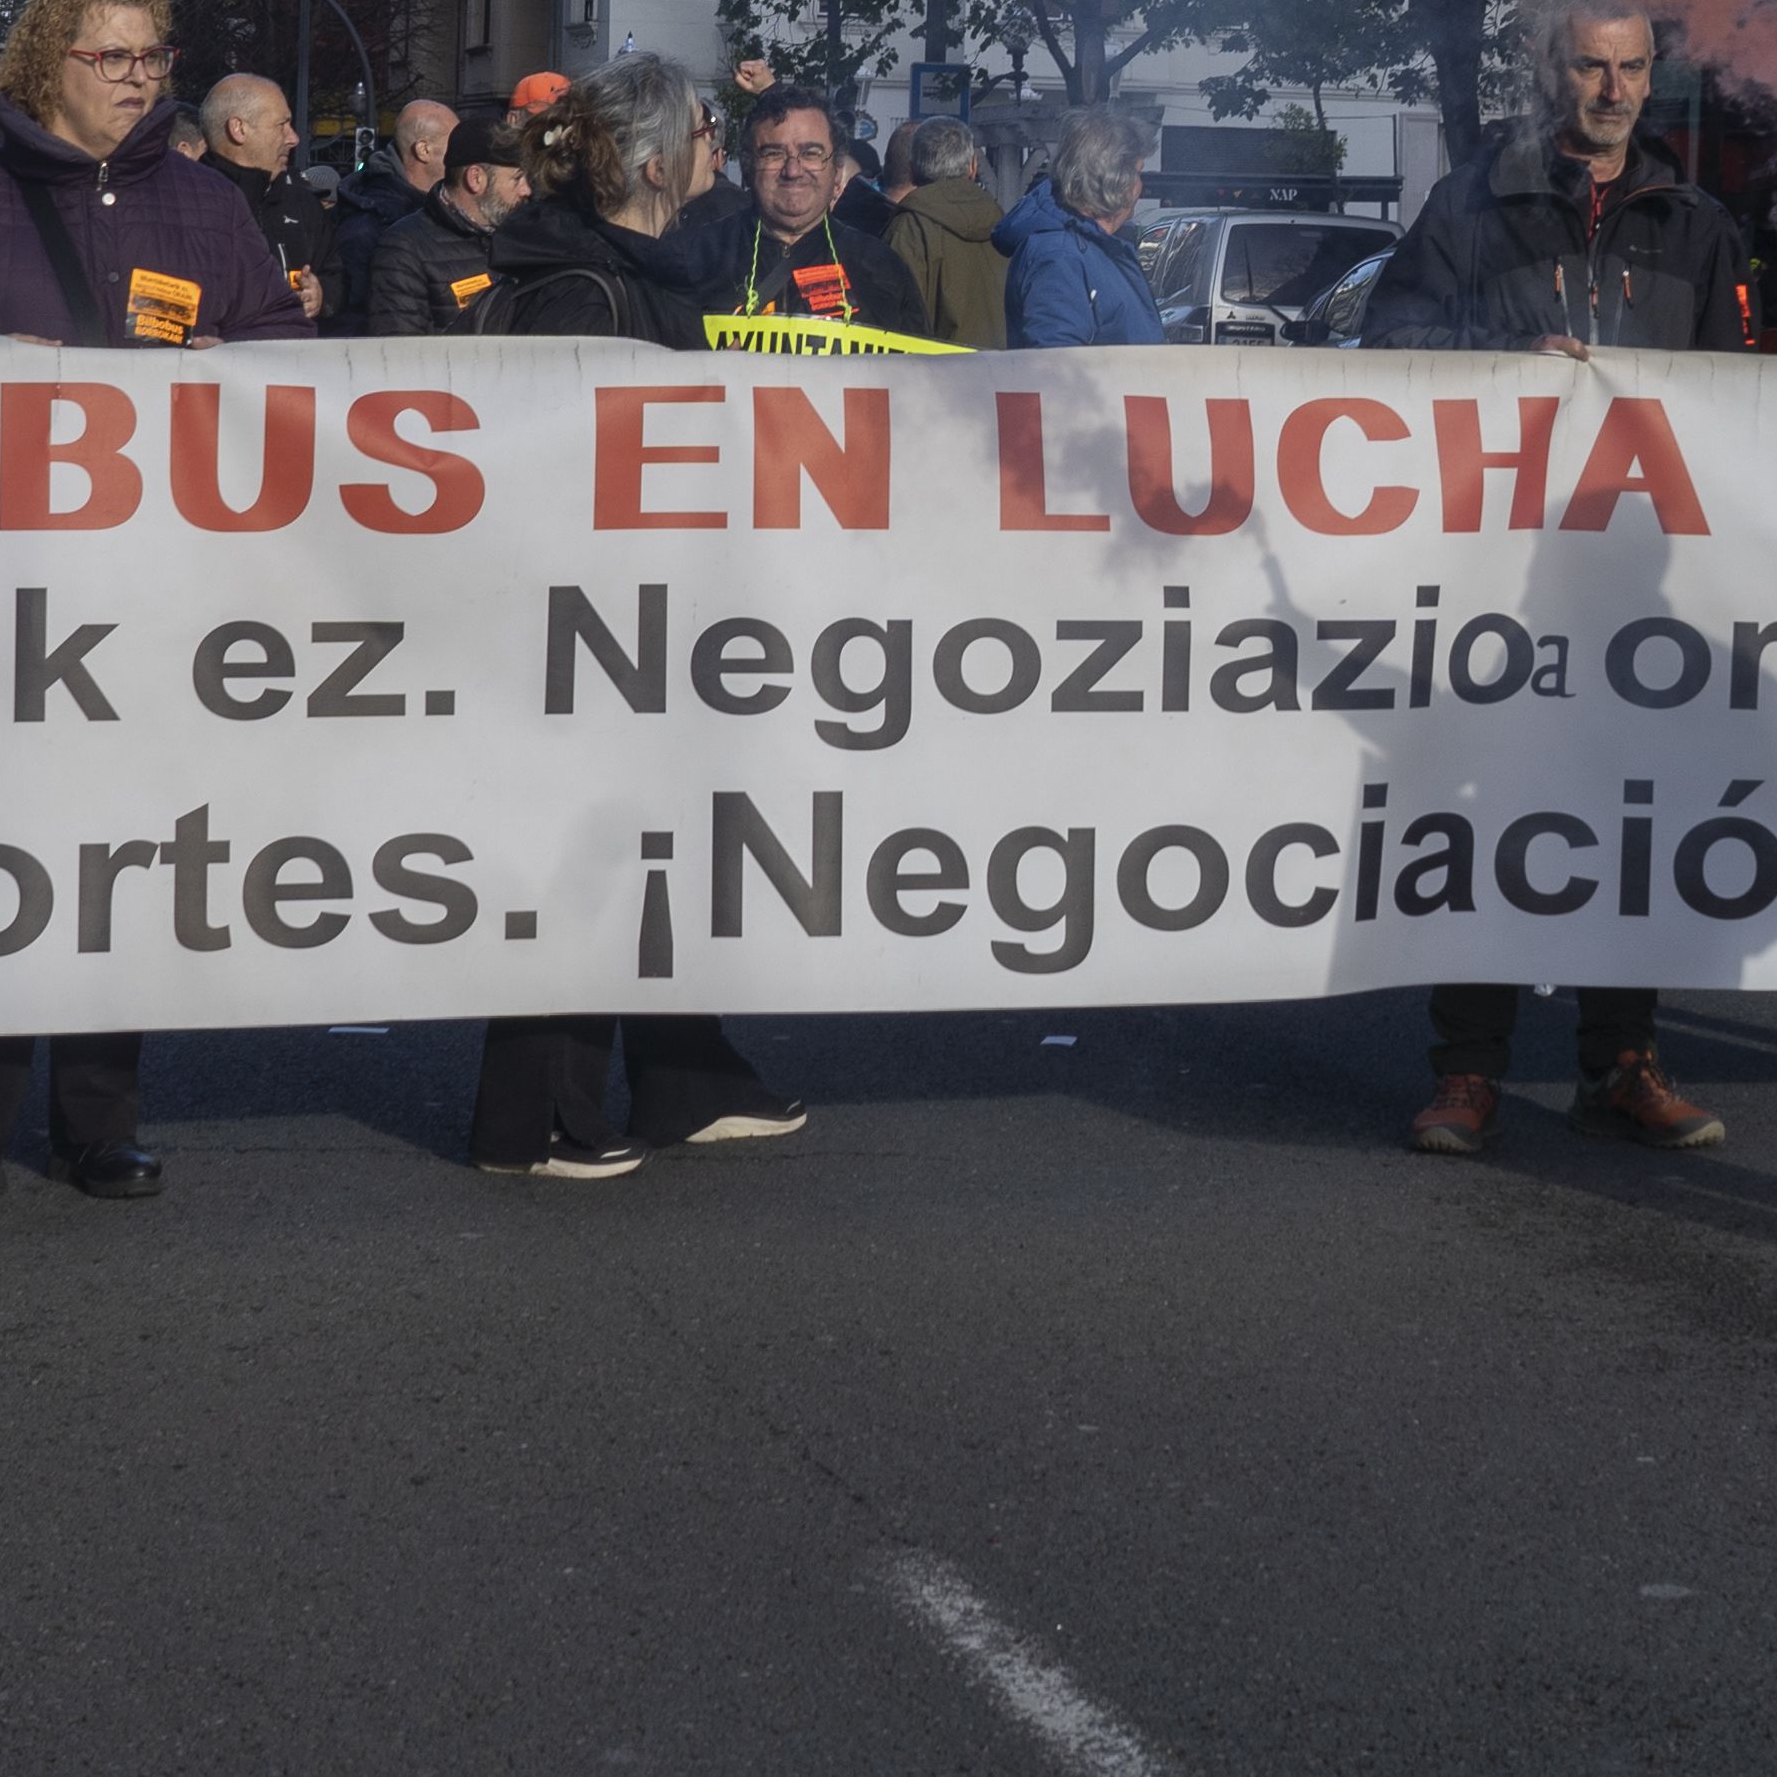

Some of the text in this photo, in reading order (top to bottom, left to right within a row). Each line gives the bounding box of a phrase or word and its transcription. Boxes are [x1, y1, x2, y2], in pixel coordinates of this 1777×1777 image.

[594, 387, 891, 529] EN
[998, 391, 1712, 535] LUCHA
[192, 620, 456, 722] ez.
[543, 584, 1577, 752] Negoziazioa
